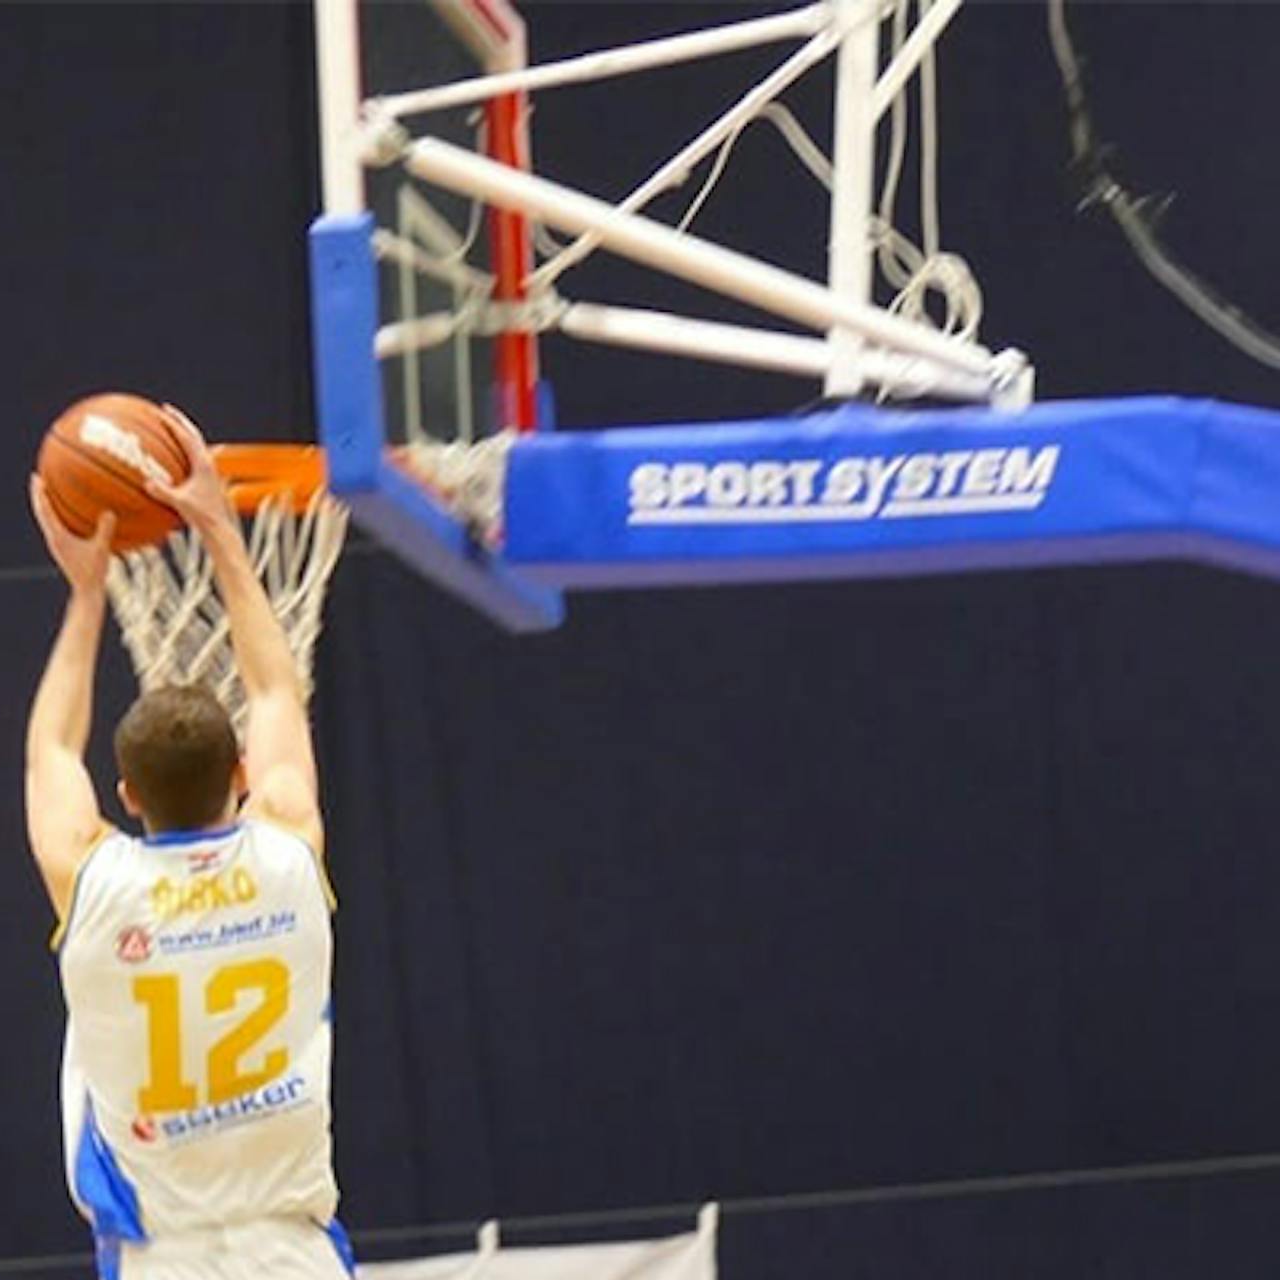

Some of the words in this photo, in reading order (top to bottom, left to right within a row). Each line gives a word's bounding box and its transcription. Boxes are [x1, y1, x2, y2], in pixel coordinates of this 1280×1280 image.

[628, 462, 823, 509] SPORT
[823, 446, 1061, 517] SYSTEM
[131, 955, 293, 1114] 12
